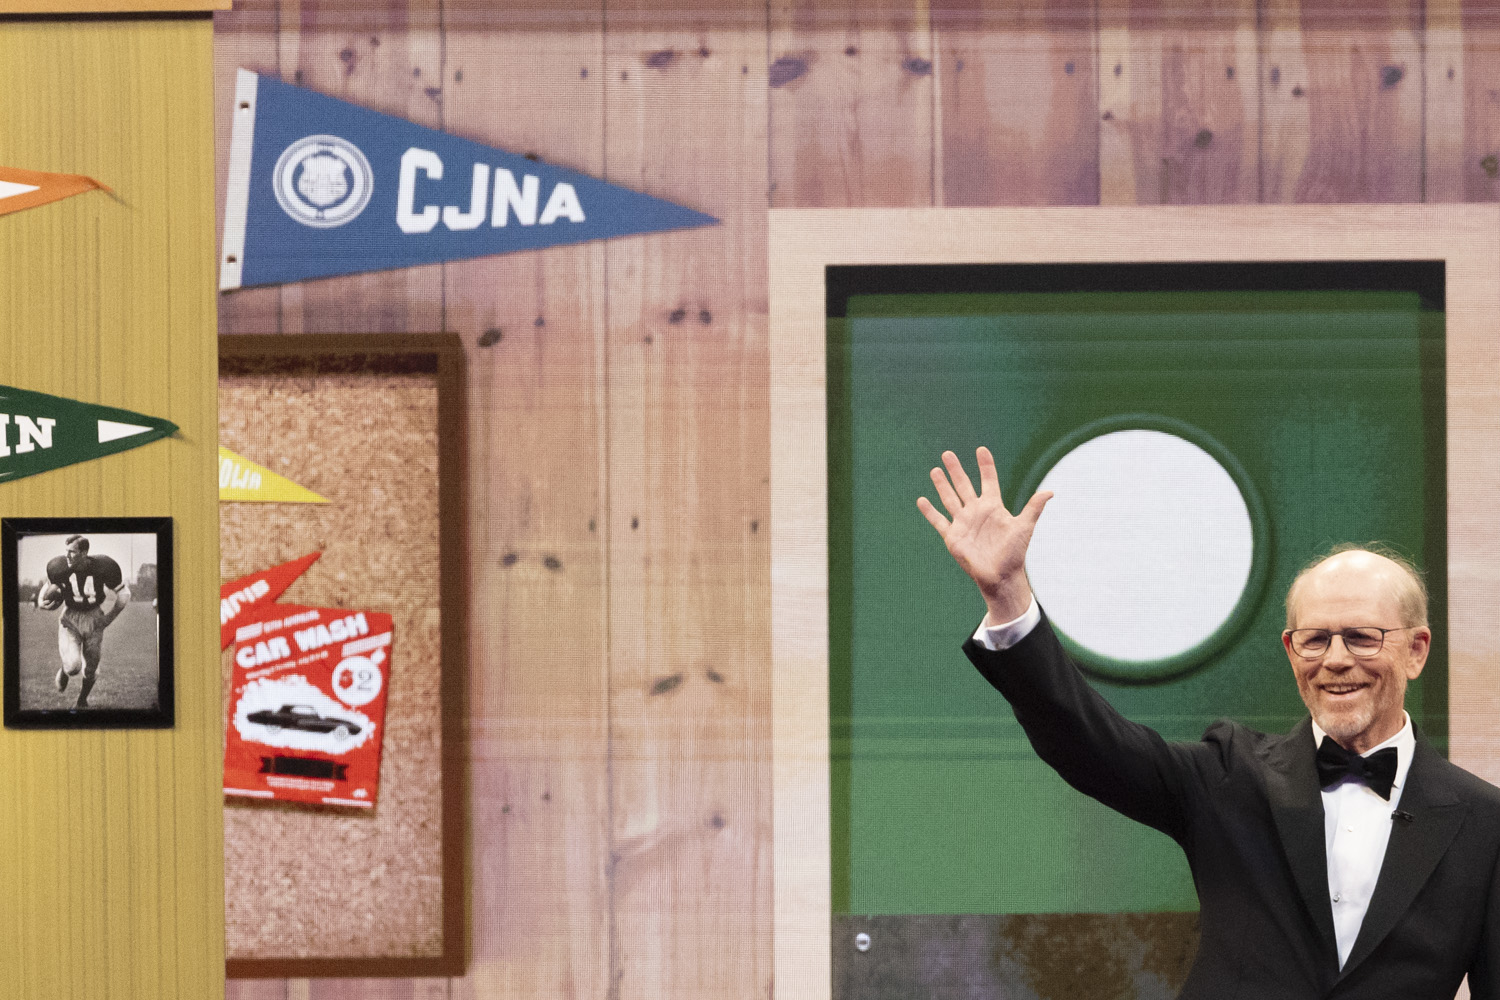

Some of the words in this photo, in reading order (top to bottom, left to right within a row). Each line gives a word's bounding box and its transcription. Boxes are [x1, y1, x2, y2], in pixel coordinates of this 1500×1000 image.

[396, 147, 586, 234] CJNA
[219, 457, 262, 490] OWA
[69, 572, 97, 604] 14
[236, 636, 291, 669] CAR
[293, 612, 370, 652] WASH
